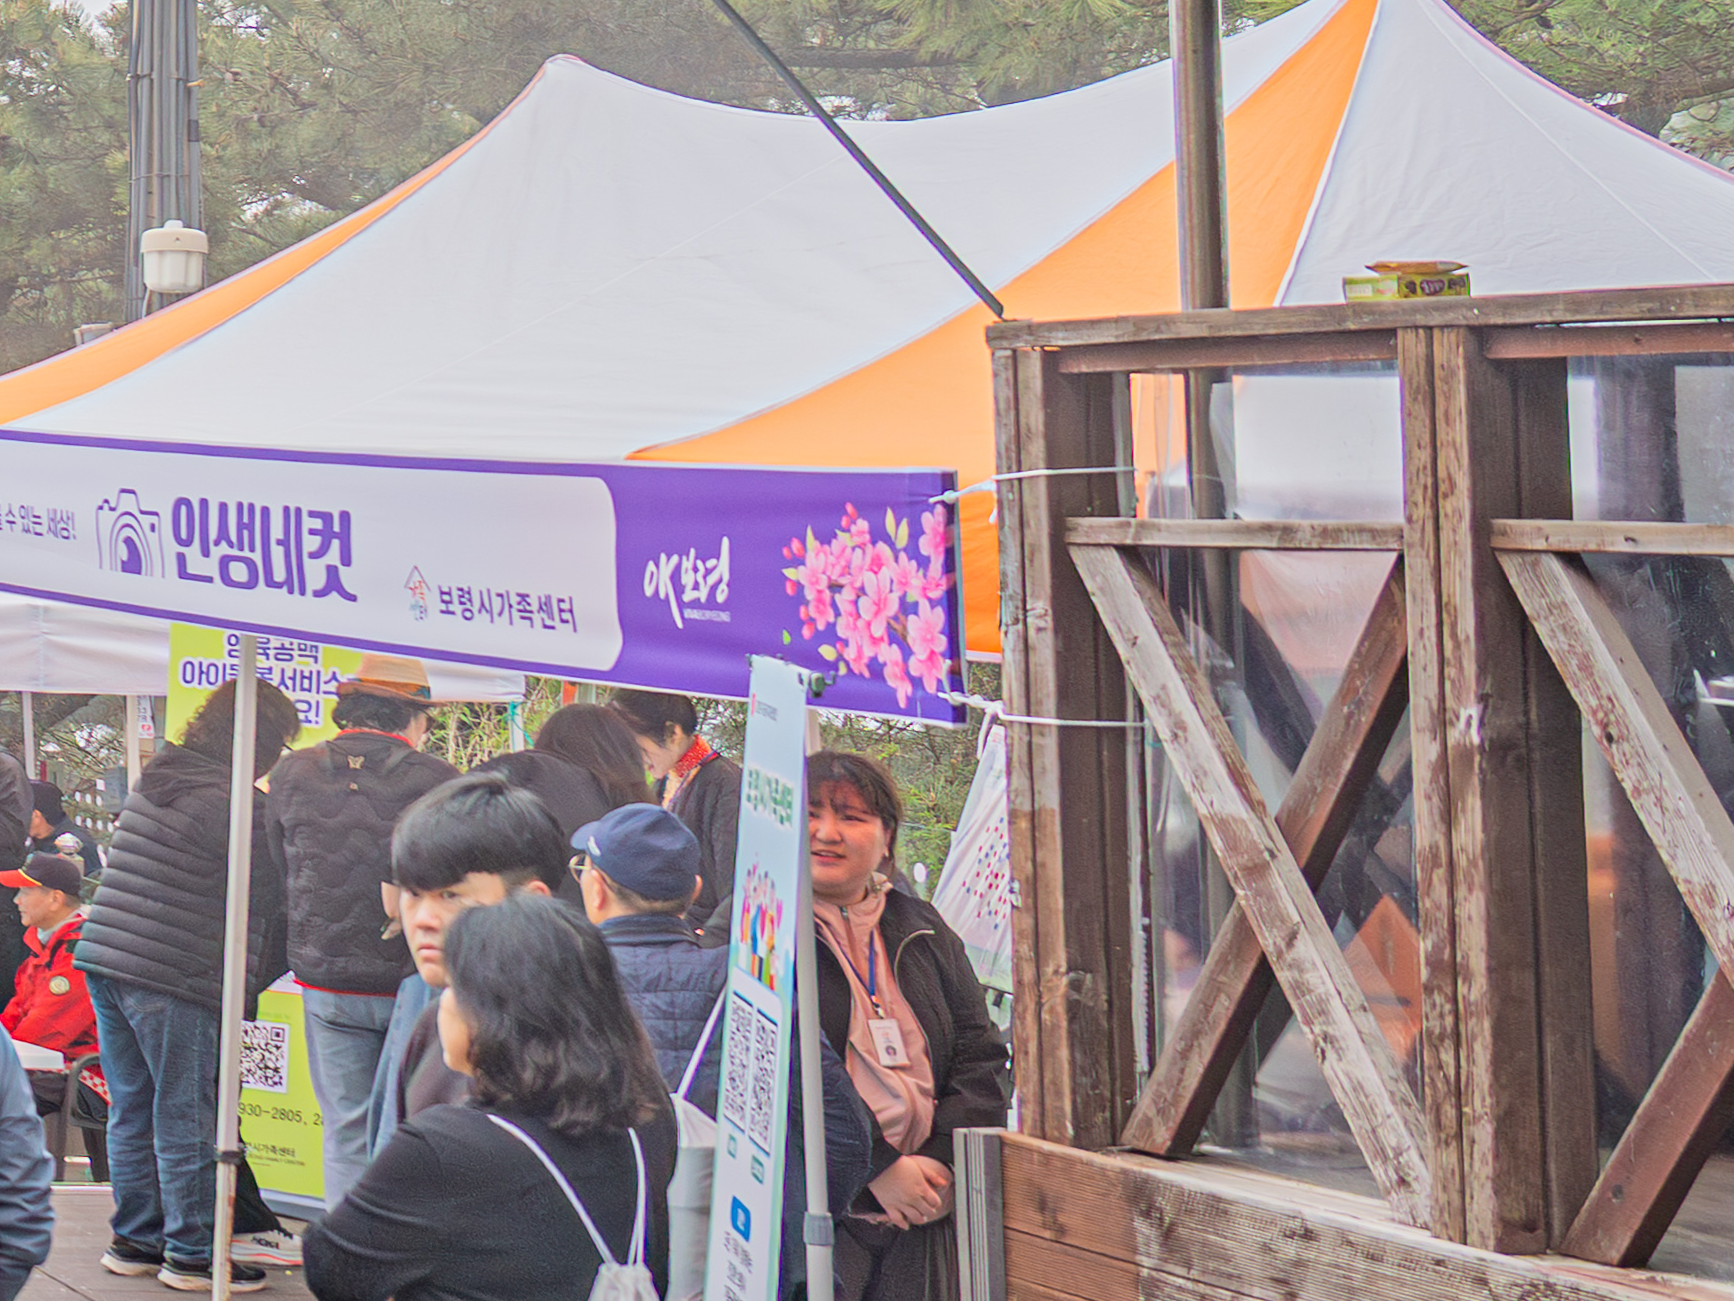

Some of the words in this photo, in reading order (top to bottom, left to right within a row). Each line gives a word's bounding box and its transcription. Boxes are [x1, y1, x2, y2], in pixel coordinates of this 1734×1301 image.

[5, 502, 16, 533] 수
[18, 504, 44, 537] 있는
[46, 507, 77, 540] 세상!
[171, 496, 358, 603] 인생네컷
[437, 584, 578, 633] 보령시가족센터
[182, 659, 341, 696] 아이서비스
